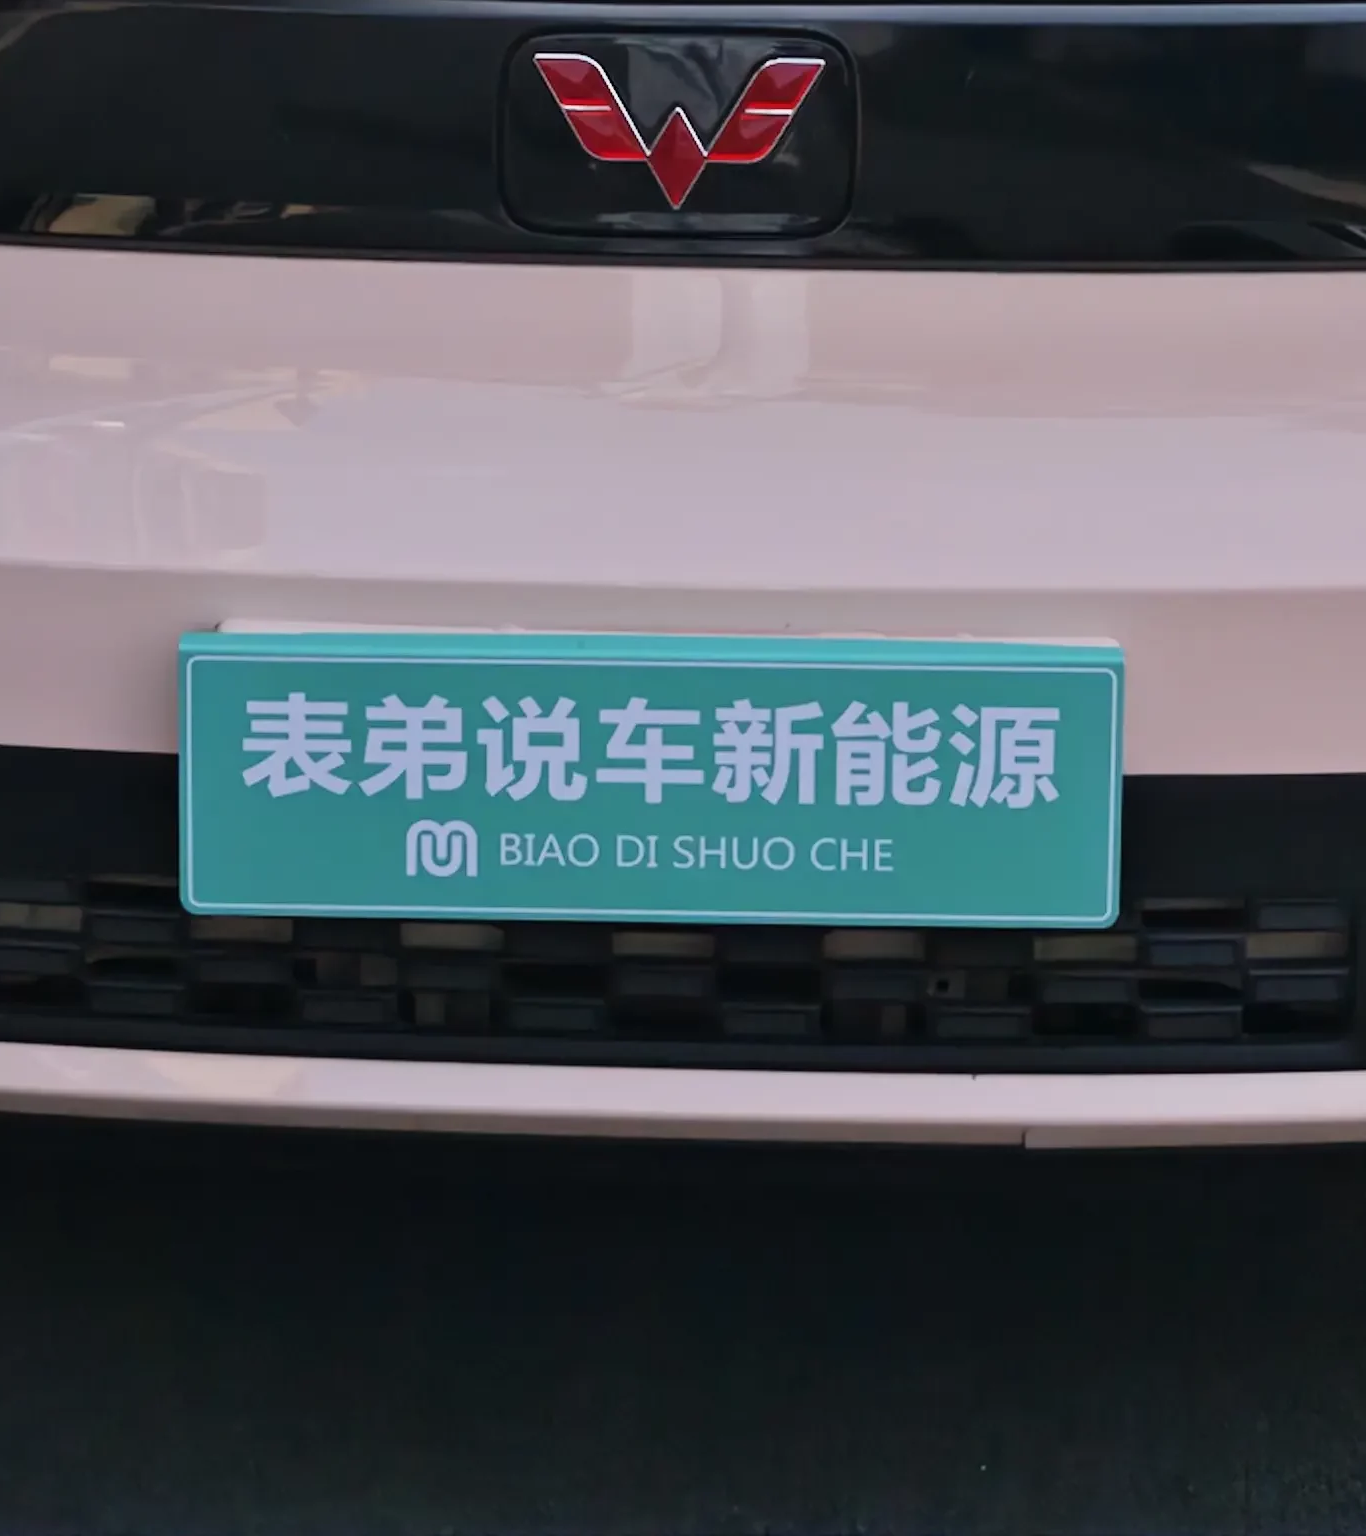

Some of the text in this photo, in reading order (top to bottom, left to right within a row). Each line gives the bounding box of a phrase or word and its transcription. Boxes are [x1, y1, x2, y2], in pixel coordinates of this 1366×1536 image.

[241, 691, 1061, 809] 表弟说车新能源
[500, 832, 894, 872] BIAO DI SHUO CHE
